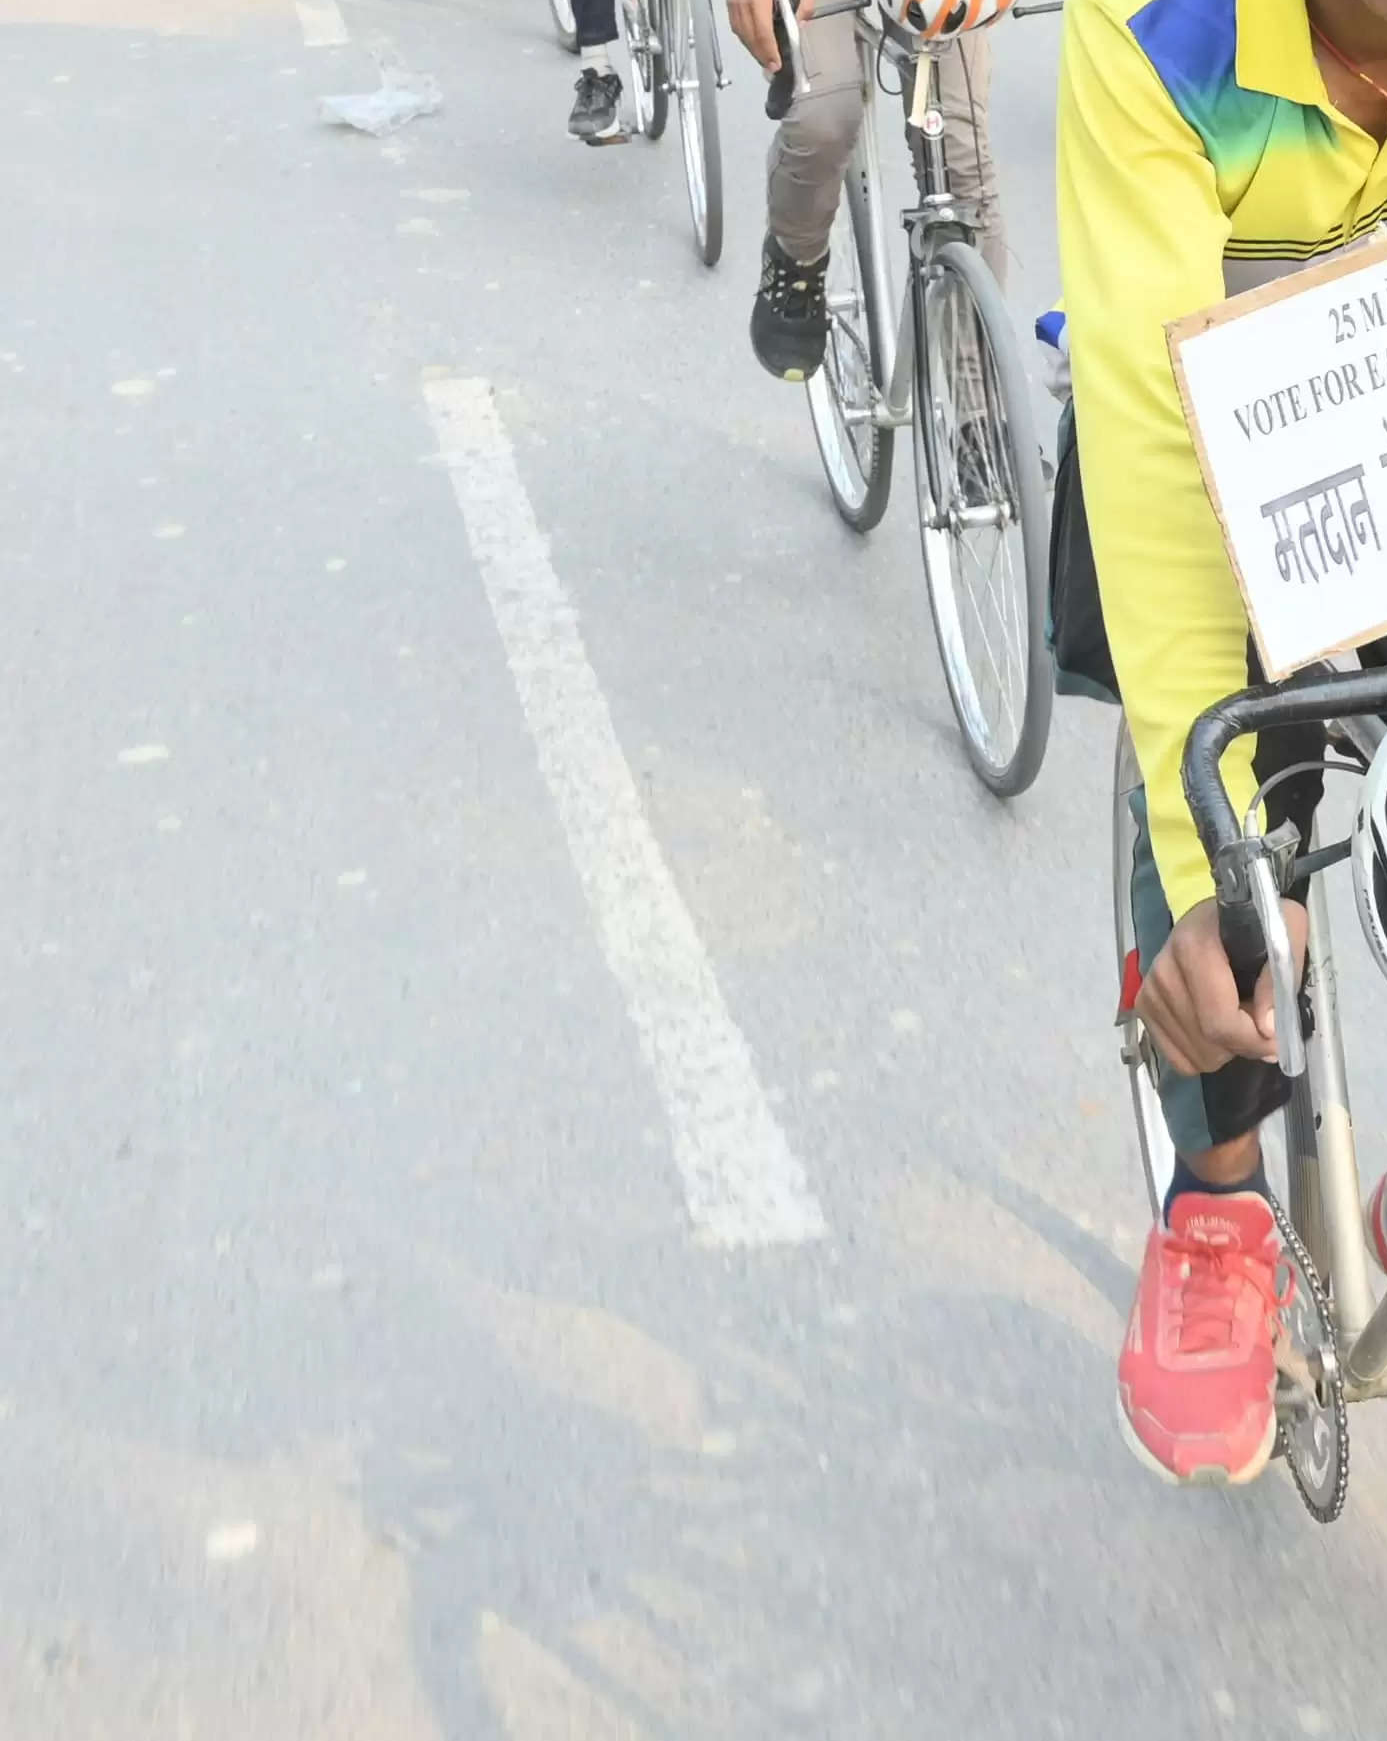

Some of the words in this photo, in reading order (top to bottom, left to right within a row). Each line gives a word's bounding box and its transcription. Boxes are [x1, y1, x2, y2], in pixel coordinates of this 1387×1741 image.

[1328, 306, 1353, 344] 25
[1233, 383, 1307, 444] VOTE
[1308, 362, 1364, 415] FOR
[1260, 463, 1381, 584] मतदान
